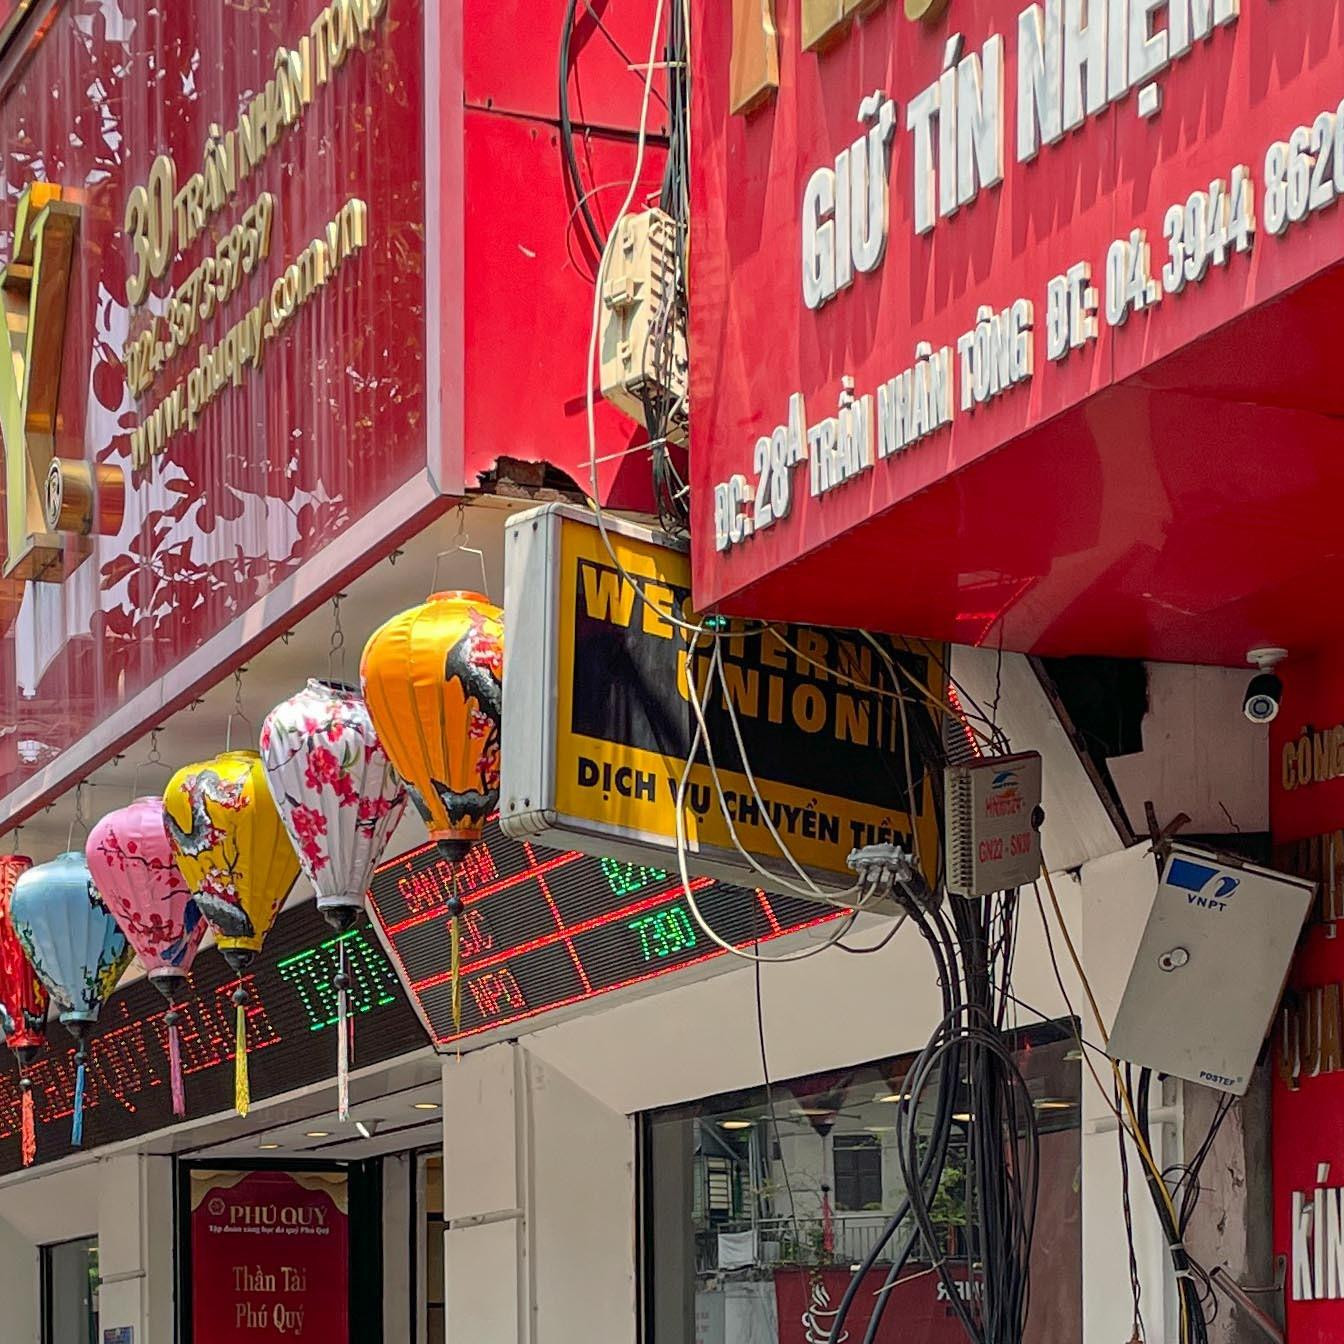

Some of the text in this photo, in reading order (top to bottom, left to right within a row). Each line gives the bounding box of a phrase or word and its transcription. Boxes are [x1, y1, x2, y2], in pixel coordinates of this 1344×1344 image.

[124, 154, 176, 307] 30
[174, 123, 237, 252] TRẦN
[239, 46, 311, 180] NHÂN
[802, 90, 896, 310] GIỮ
[907, 32, 1004, 235] TÍN
[131, 198, 367, 471] www.phuquy.com.vn
[808, 376, 874, 499] TRẦN
[877, 342, 953, 460] NHÂN
[957, 299, 1033, 412] TÔNG
[1047, 261, 1098, 361] ĐT:
[1106, 225, 1162, 326] 04.
[1163, 164, 1254, 295] 3944
[677, 648, 871, 746] UNION
[578, 757, 656, 802] DỊCH
[722, 790, 840, 845] CHUYỂN
[1187, 893, 1227, 912] VNPT
[230, 1203, 328, 1226] PHÚ QUÝ
[233, 1264, 307, 1293] Thần Tài
[235, 1302, 306, 1335] Phú Quý
